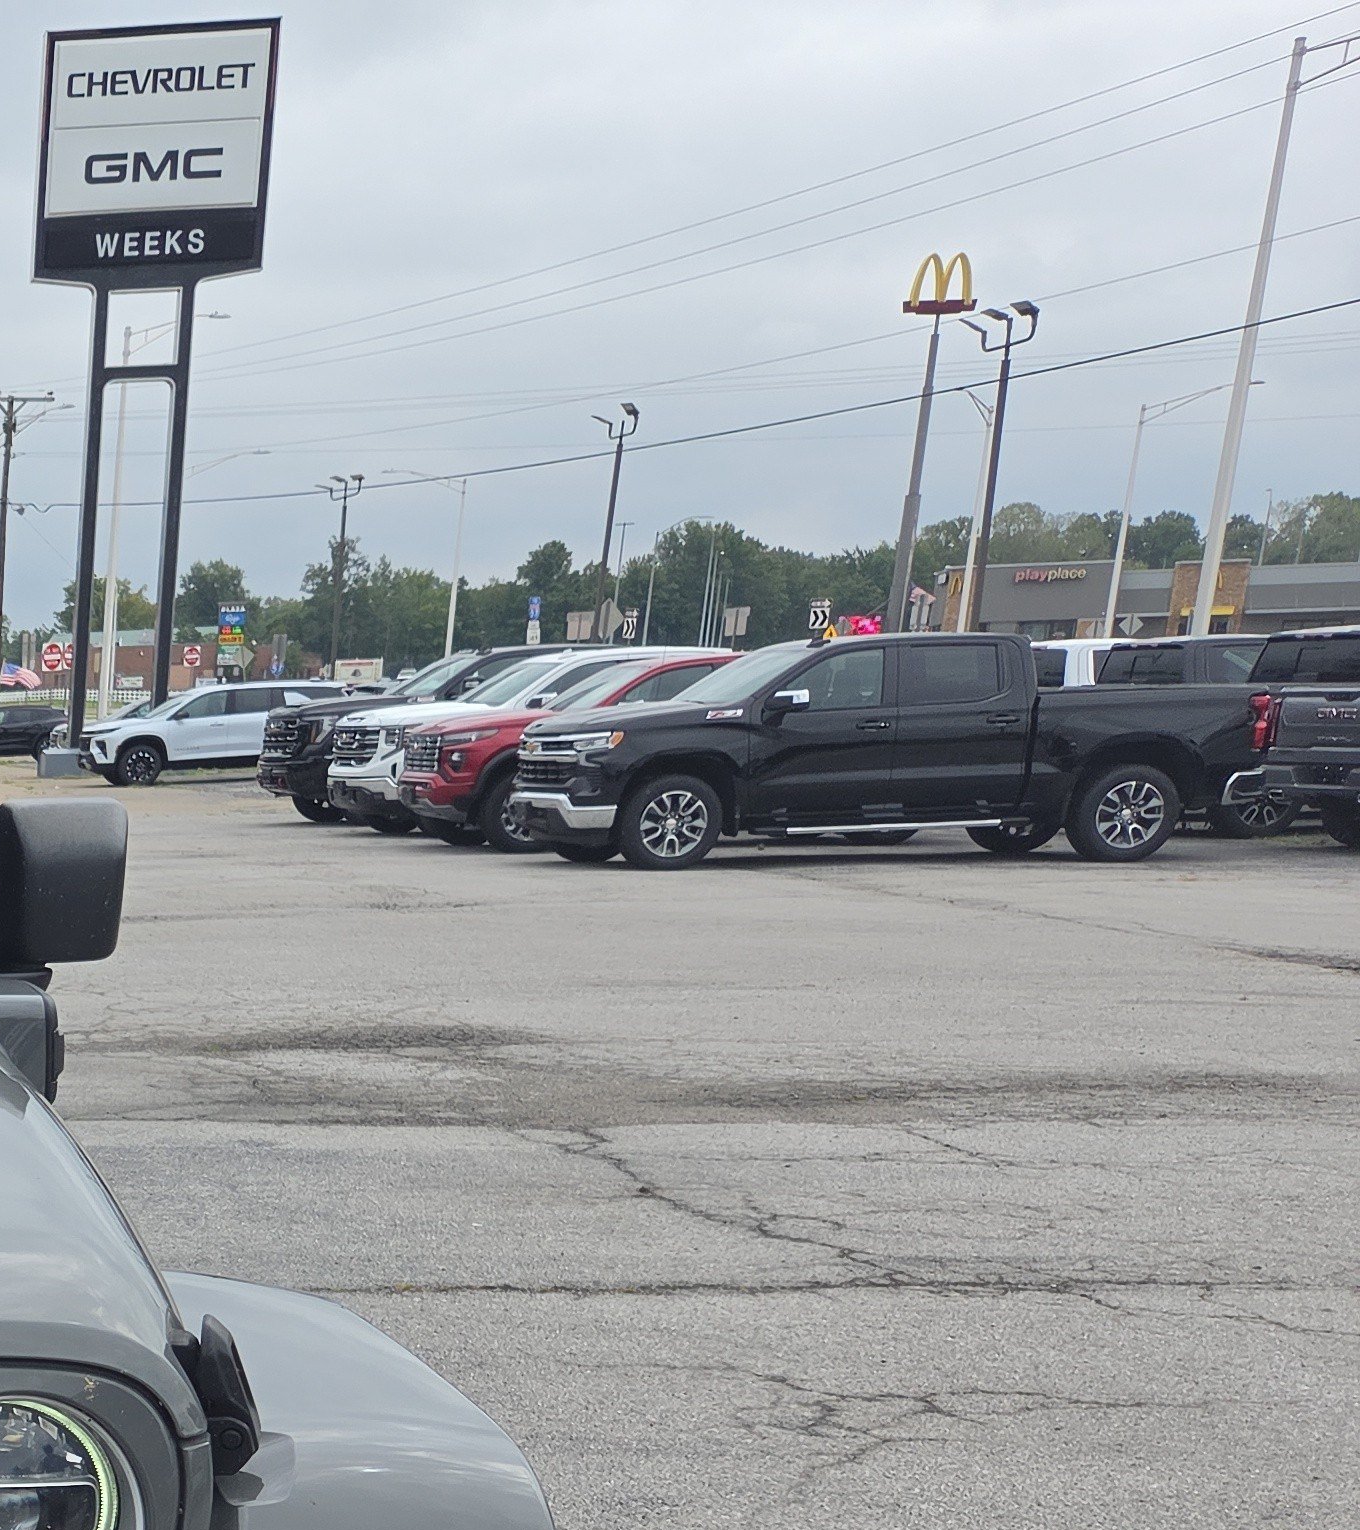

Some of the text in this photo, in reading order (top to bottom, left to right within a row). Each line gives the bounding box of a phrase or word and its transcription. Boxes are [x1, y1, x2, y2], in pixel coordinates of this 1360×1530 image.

[66, 62, 256, 98] CHEVROLET
[84, 147, 223, 184] GMC
[95, 228, 205, 258] WEEKS
